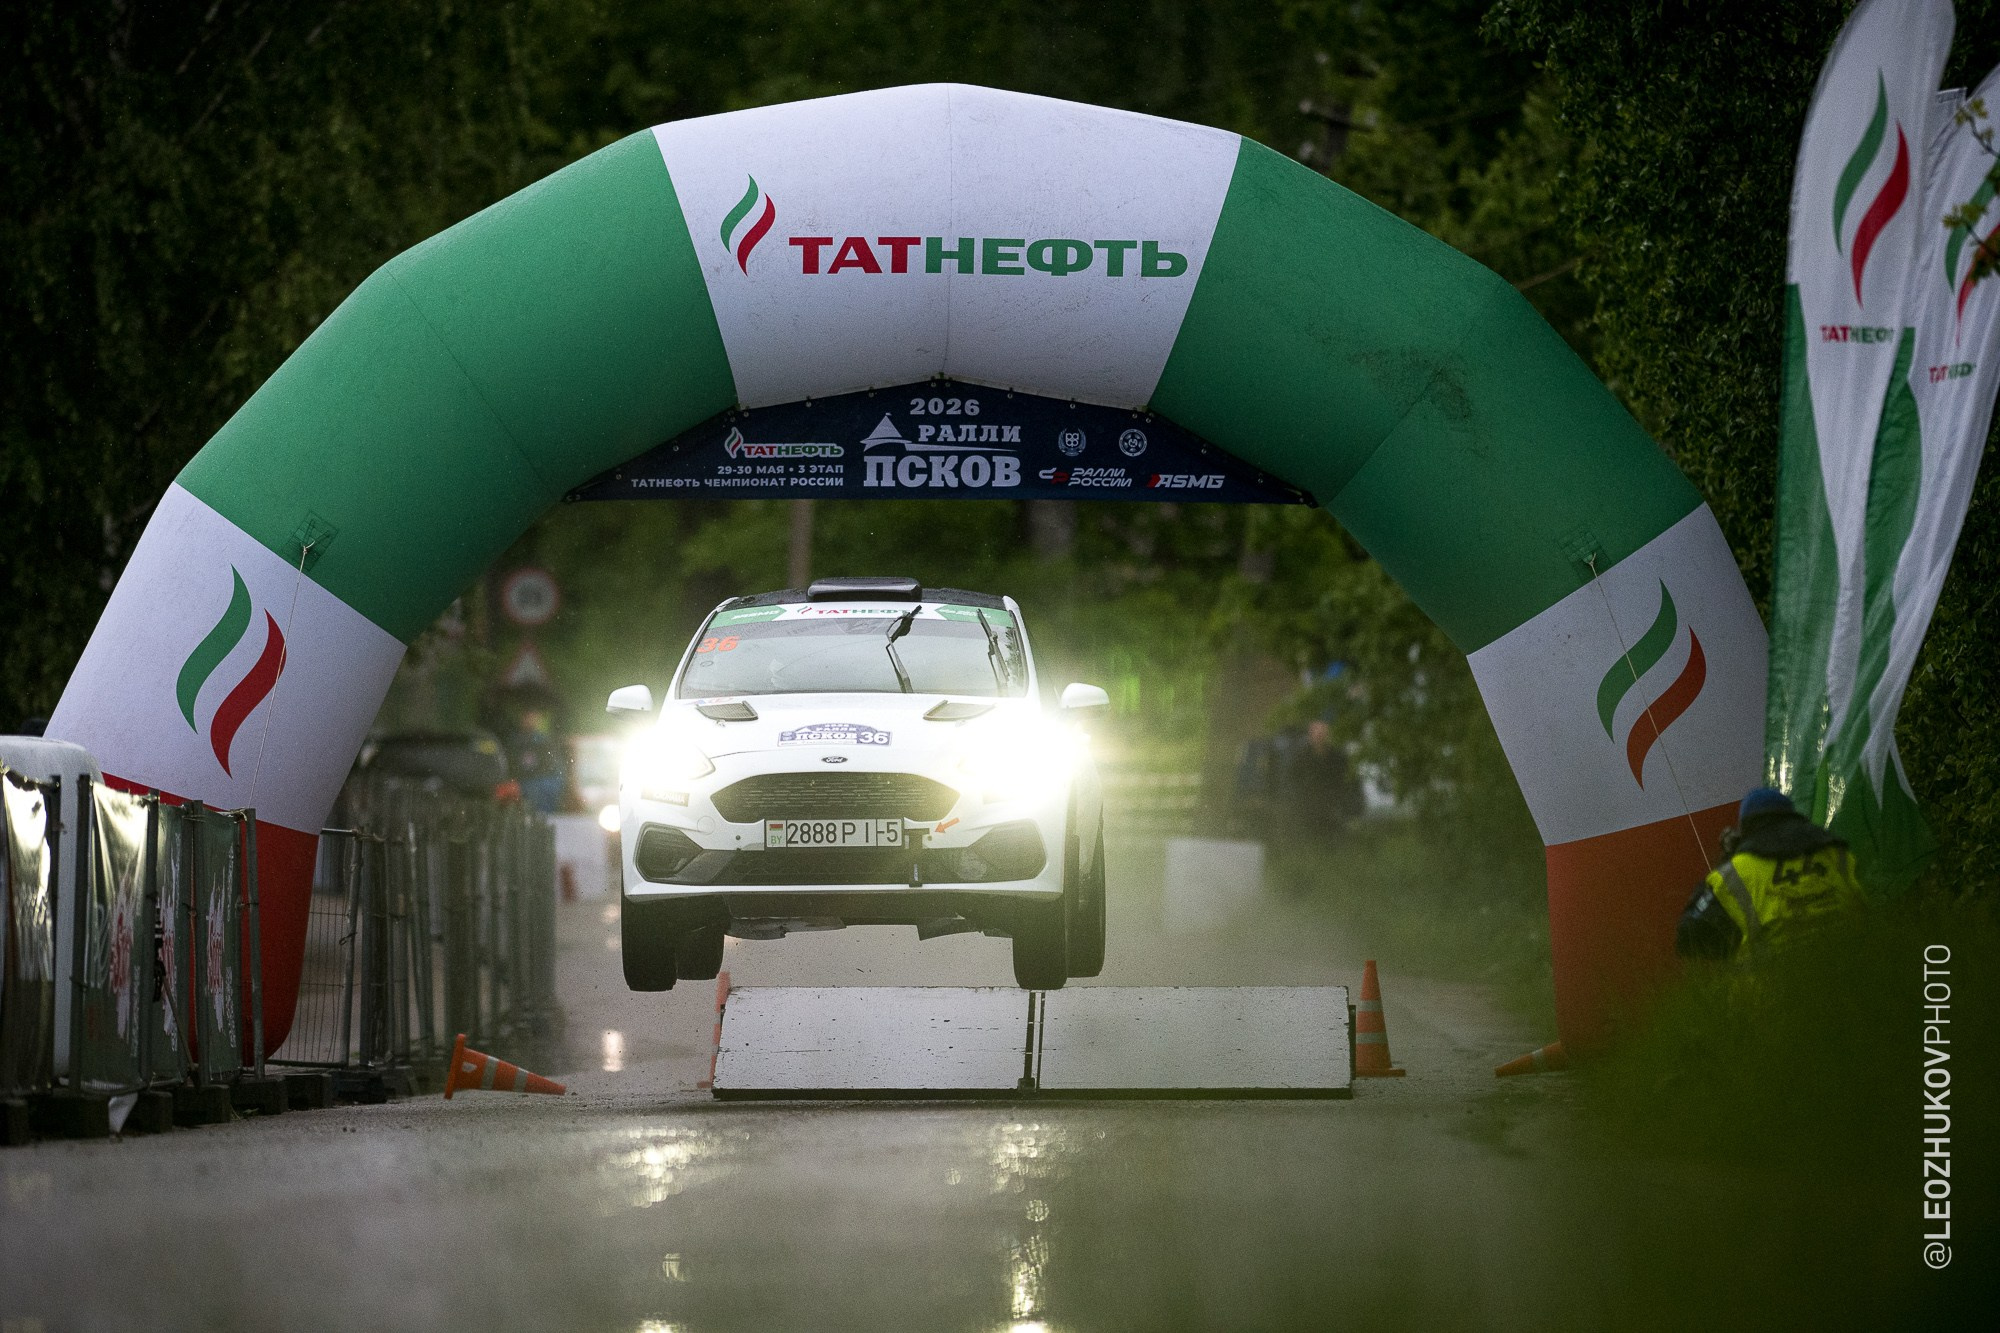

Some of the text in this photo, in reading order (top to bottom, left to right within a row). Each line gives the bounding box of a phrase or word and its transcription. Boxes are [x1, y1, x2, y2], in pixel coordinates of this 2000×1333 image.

[788, 236, 1189, 278] ТАТНЕФТЬ
[909, 397, 981, 416] 2026
[917, 424, 1022, 443] РАЛЛИ
[743, 443, 844, 459] ТАТНЕФТЬ
[717, 464, 844, 475] 29-30 МАЯ 3 ЭТАП
[863, 454, 1022, 488] ПСКОВ
[1072, 467, 1126, 477] РАЛЛИ
[631, 477, 844, 488] ТАТНЕФТЬ ЧЕМПИОНАТ РОССИИ
[1068, 477, 1132, 487] РОССИИ
[1154, 474, 1226, 488] ASMG
[696, 635, 741, 653] 36
[860, 732, 889, 745] 36
[787, 822, 837, 845] 2888
